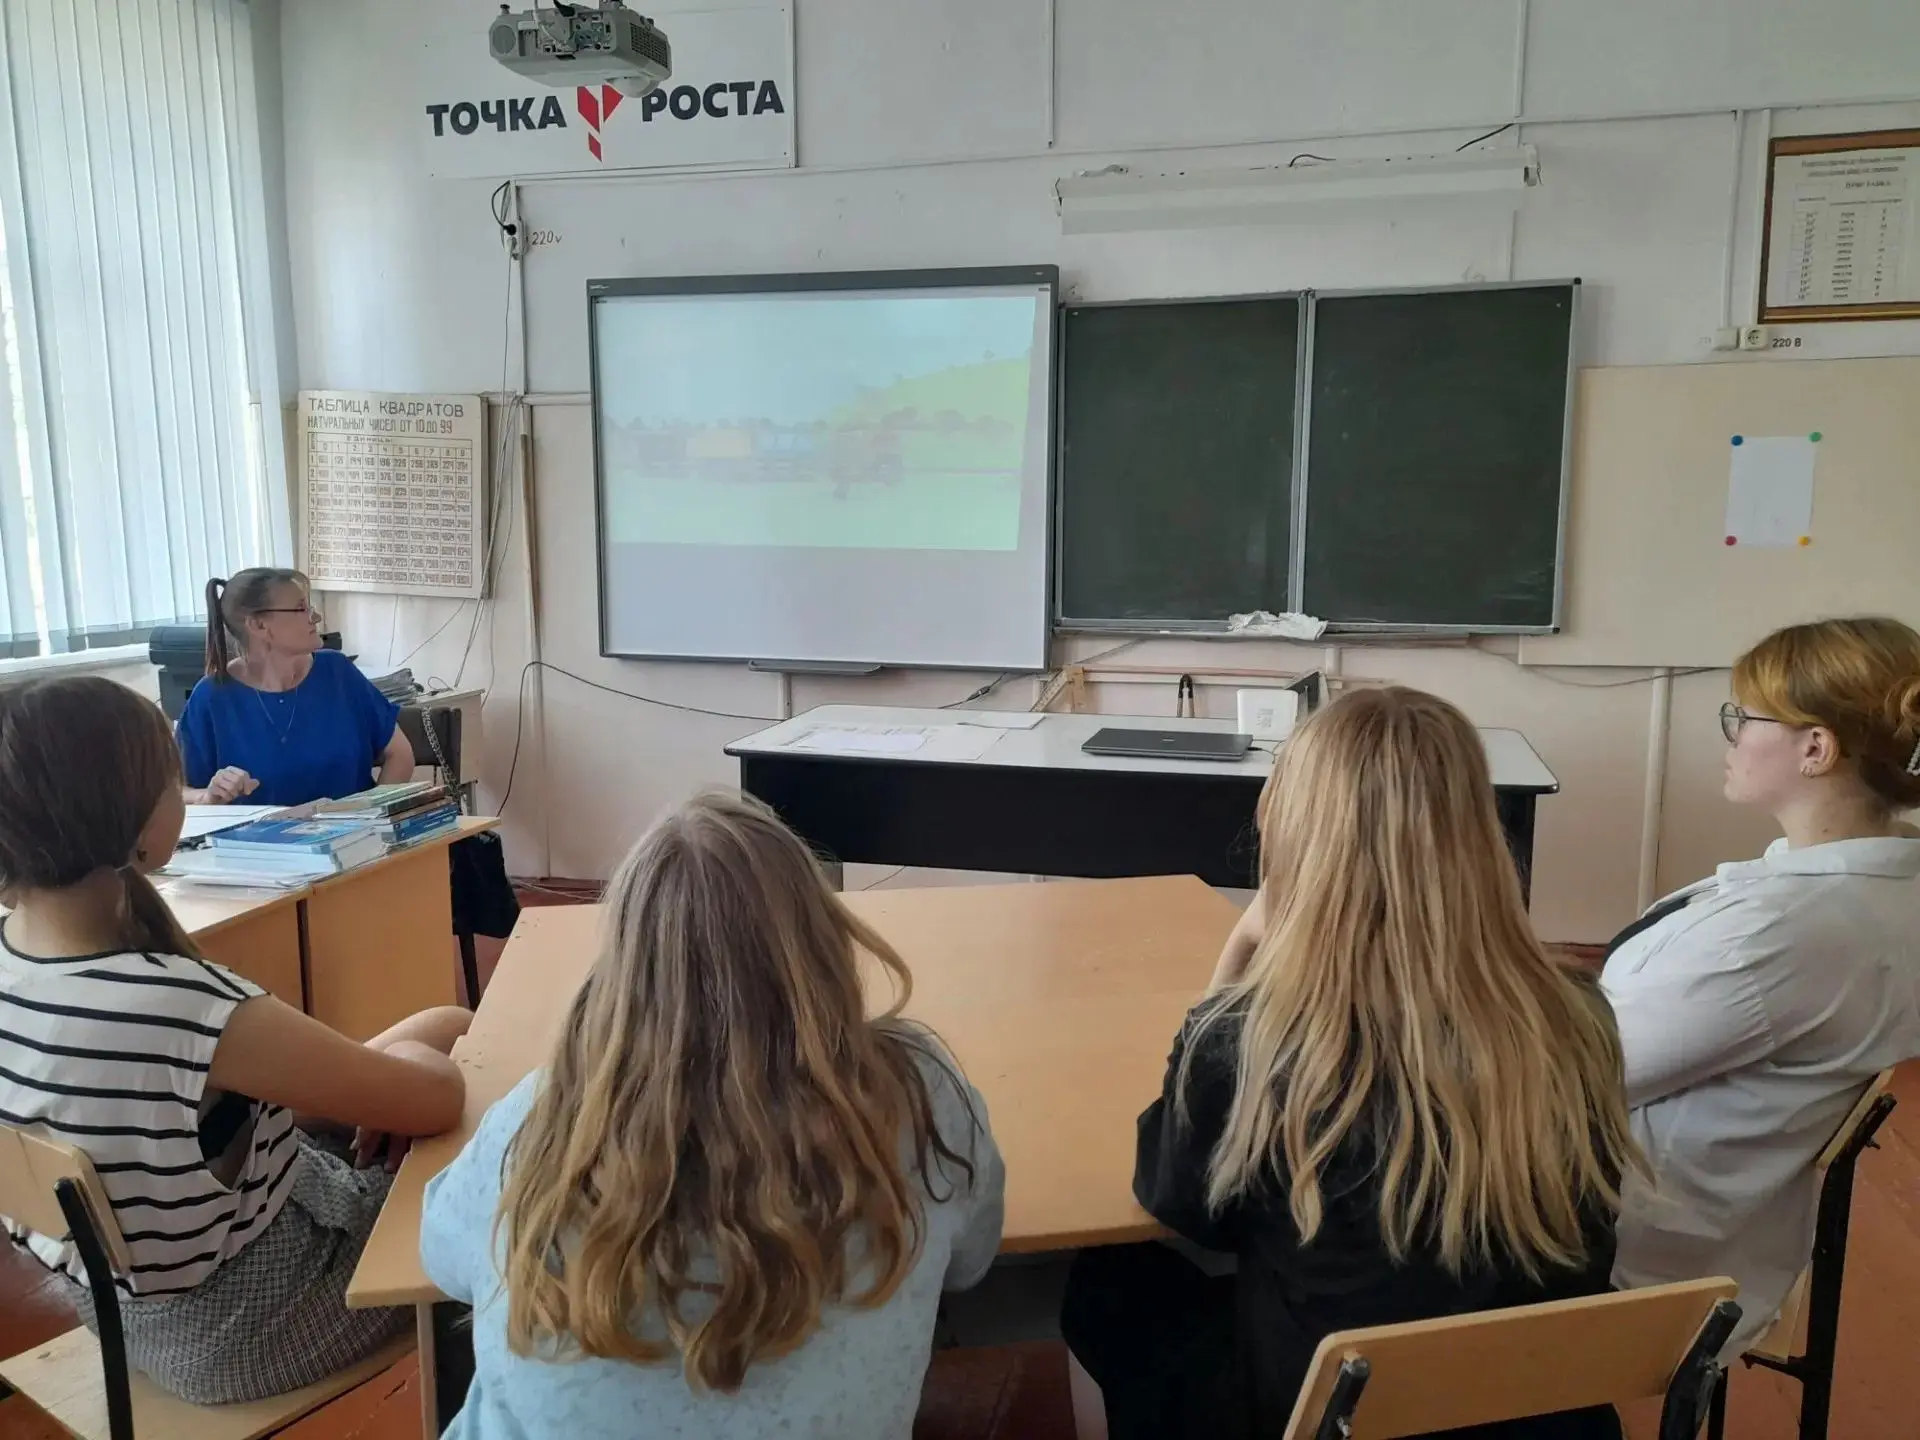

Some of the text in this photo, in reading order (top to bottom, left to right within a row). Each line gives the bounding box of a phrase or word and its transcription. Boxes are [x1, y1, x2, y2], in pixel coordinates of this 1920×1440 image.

[426, 80, 784, 136] ТОЧКА РОСТА
[1772, 337, 1792, 348] 220
[308, 397, 464, 418] ТАБЛИЦА КВАДРАТОВ
[307, 415, 365, 430] НАТУРАЛЬНЫХ
[369, 418, 396, 432] ЧИСЕЛ
[399, 420, 413, 432] ОТ
[440, 420, 452, 434] 99
